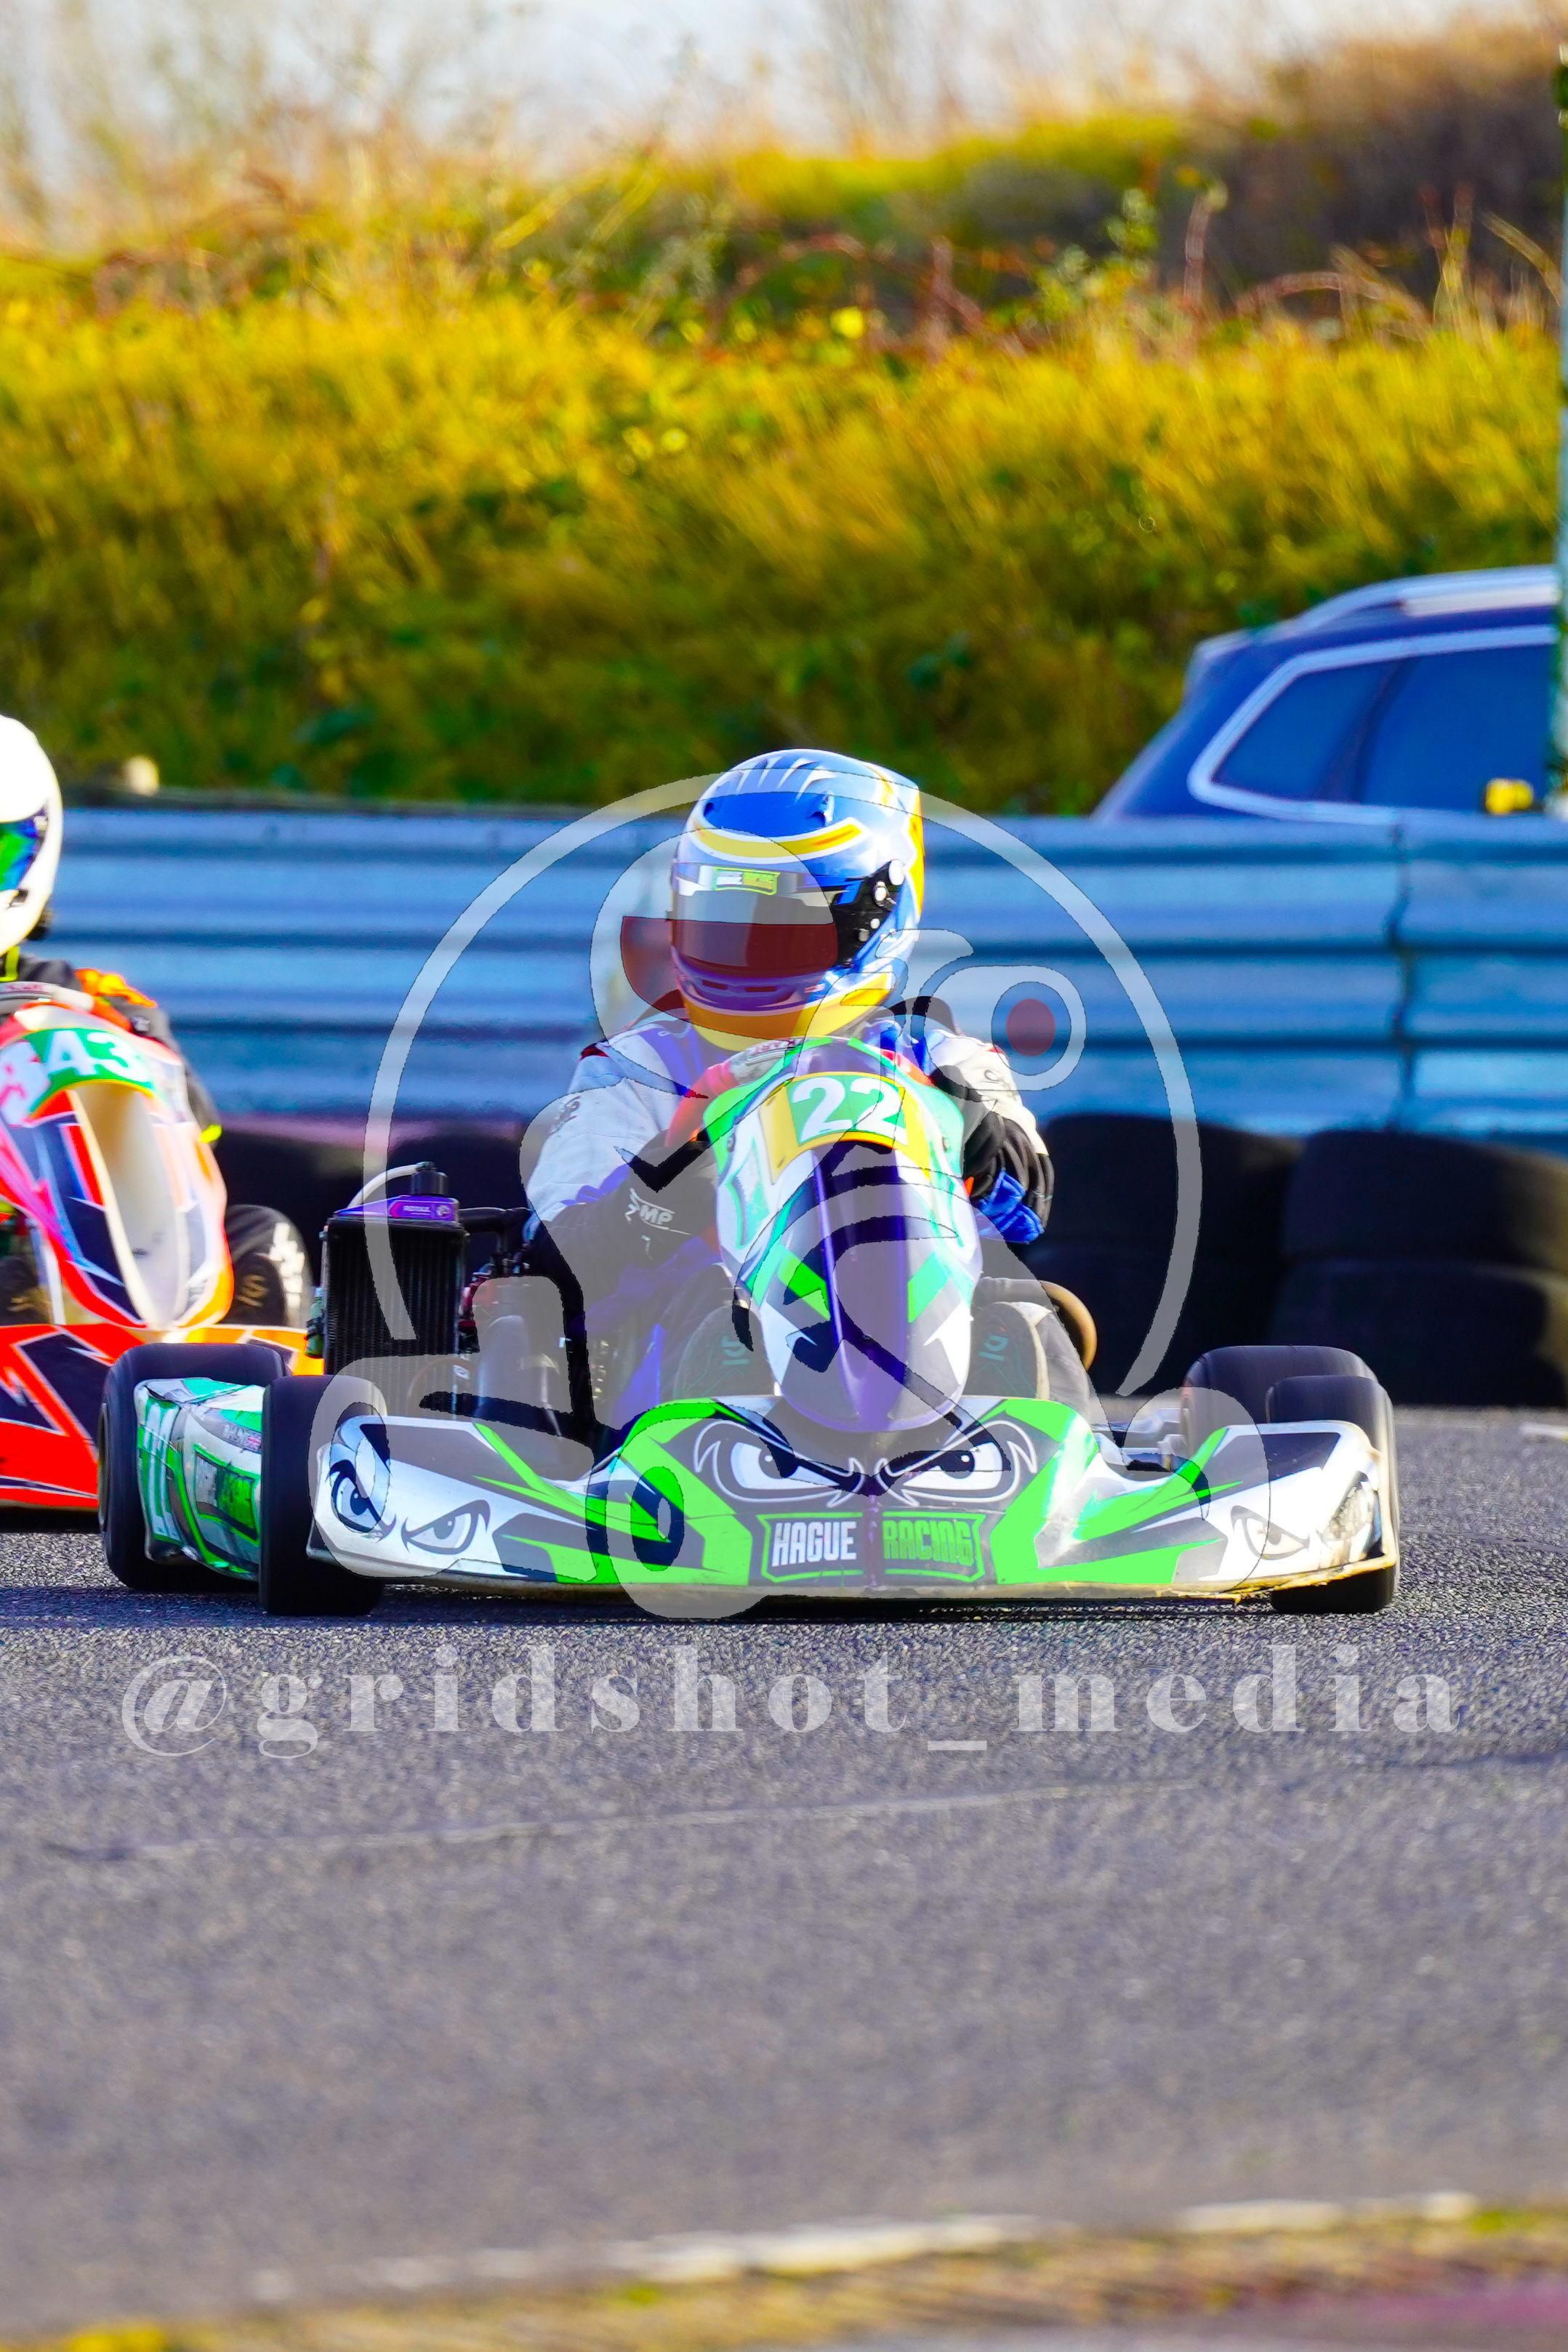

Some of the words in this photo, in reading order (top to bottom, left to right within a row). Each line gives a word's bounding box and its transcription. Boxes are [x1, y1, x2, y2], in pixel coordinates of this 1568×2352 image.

[792, 1076, 908, 1145] 22
[772, 1521, 857, 1567] HAGUE
[882, 1520, 976, 1566] RACING
